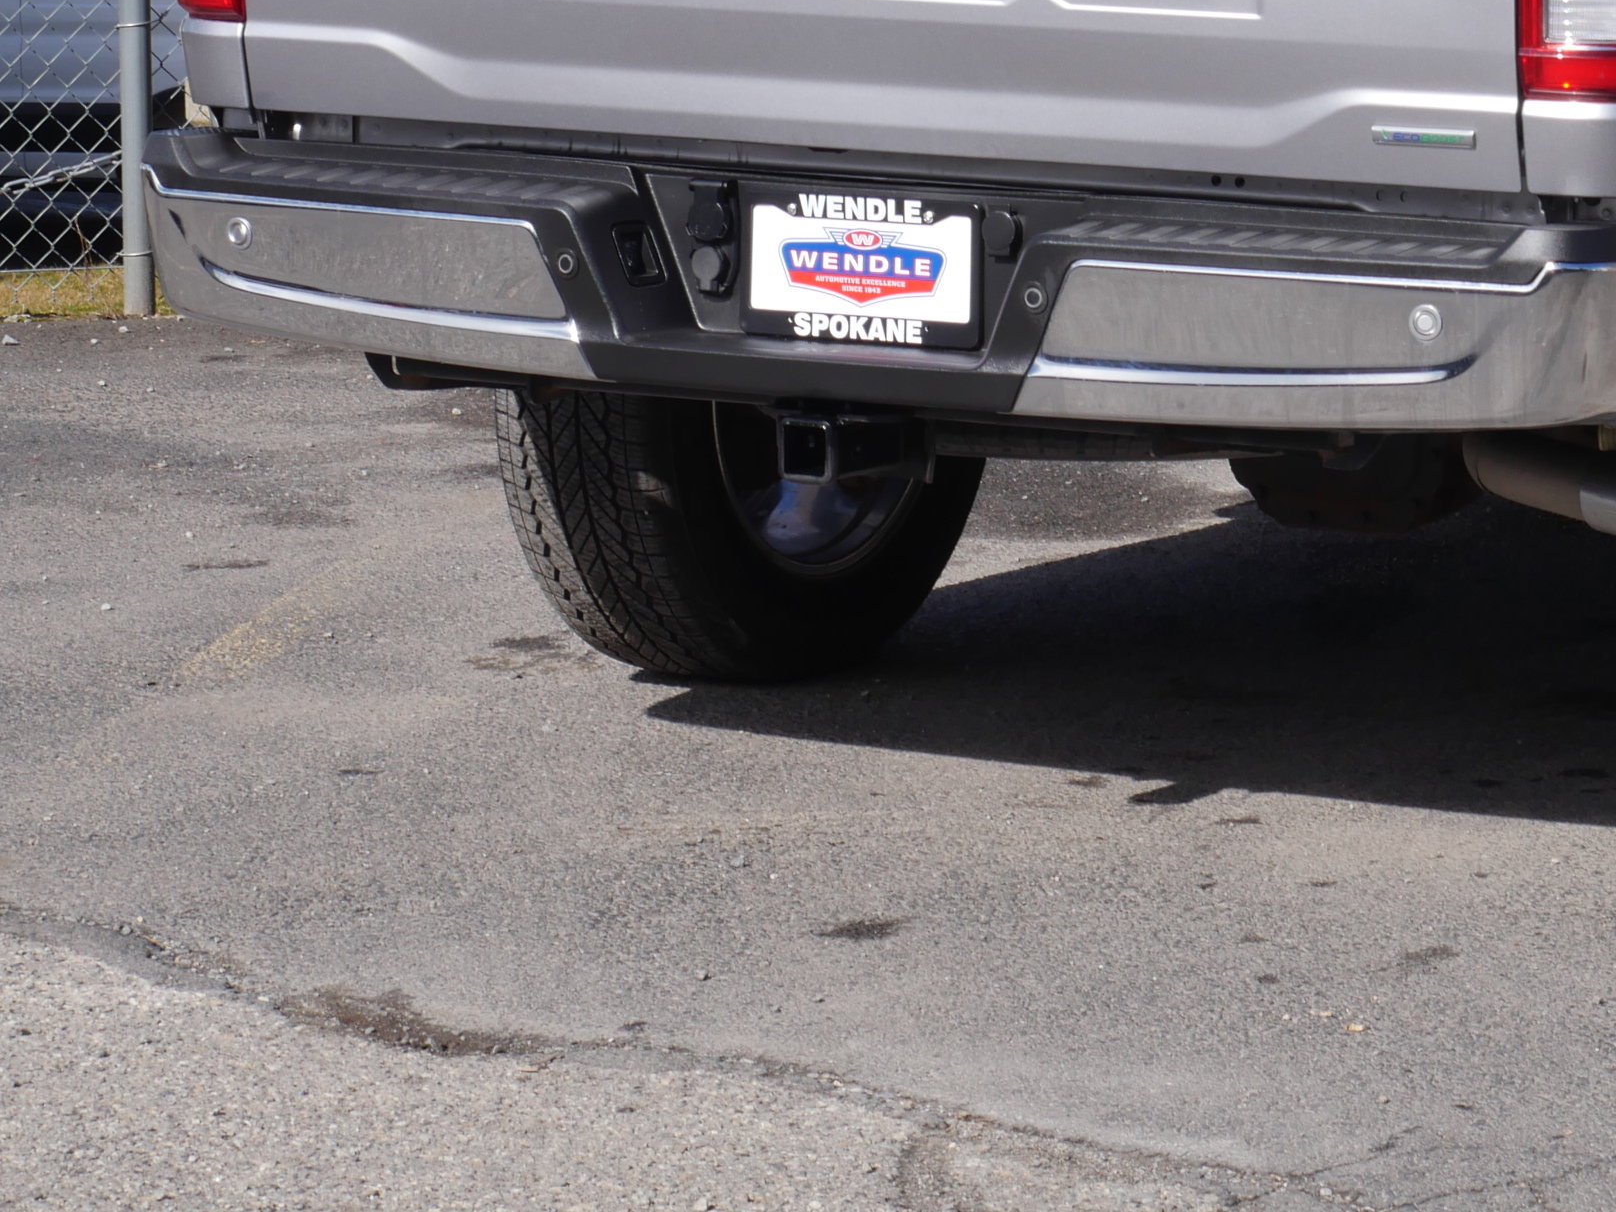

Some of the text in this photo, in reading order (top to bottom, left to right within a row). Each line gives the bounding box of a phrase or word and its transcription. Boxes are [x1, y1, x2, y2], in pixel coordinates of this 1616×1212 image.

[799, 193, 922, 225] WENDLE
[790, 249, 932, 277] WENDLE
[815, 275, 906, 288] AUTOMOTIVE EXCELLENCE
[841, 285, 863, 293] SINCE
[793, 312, 923, 344] SPOKANE
